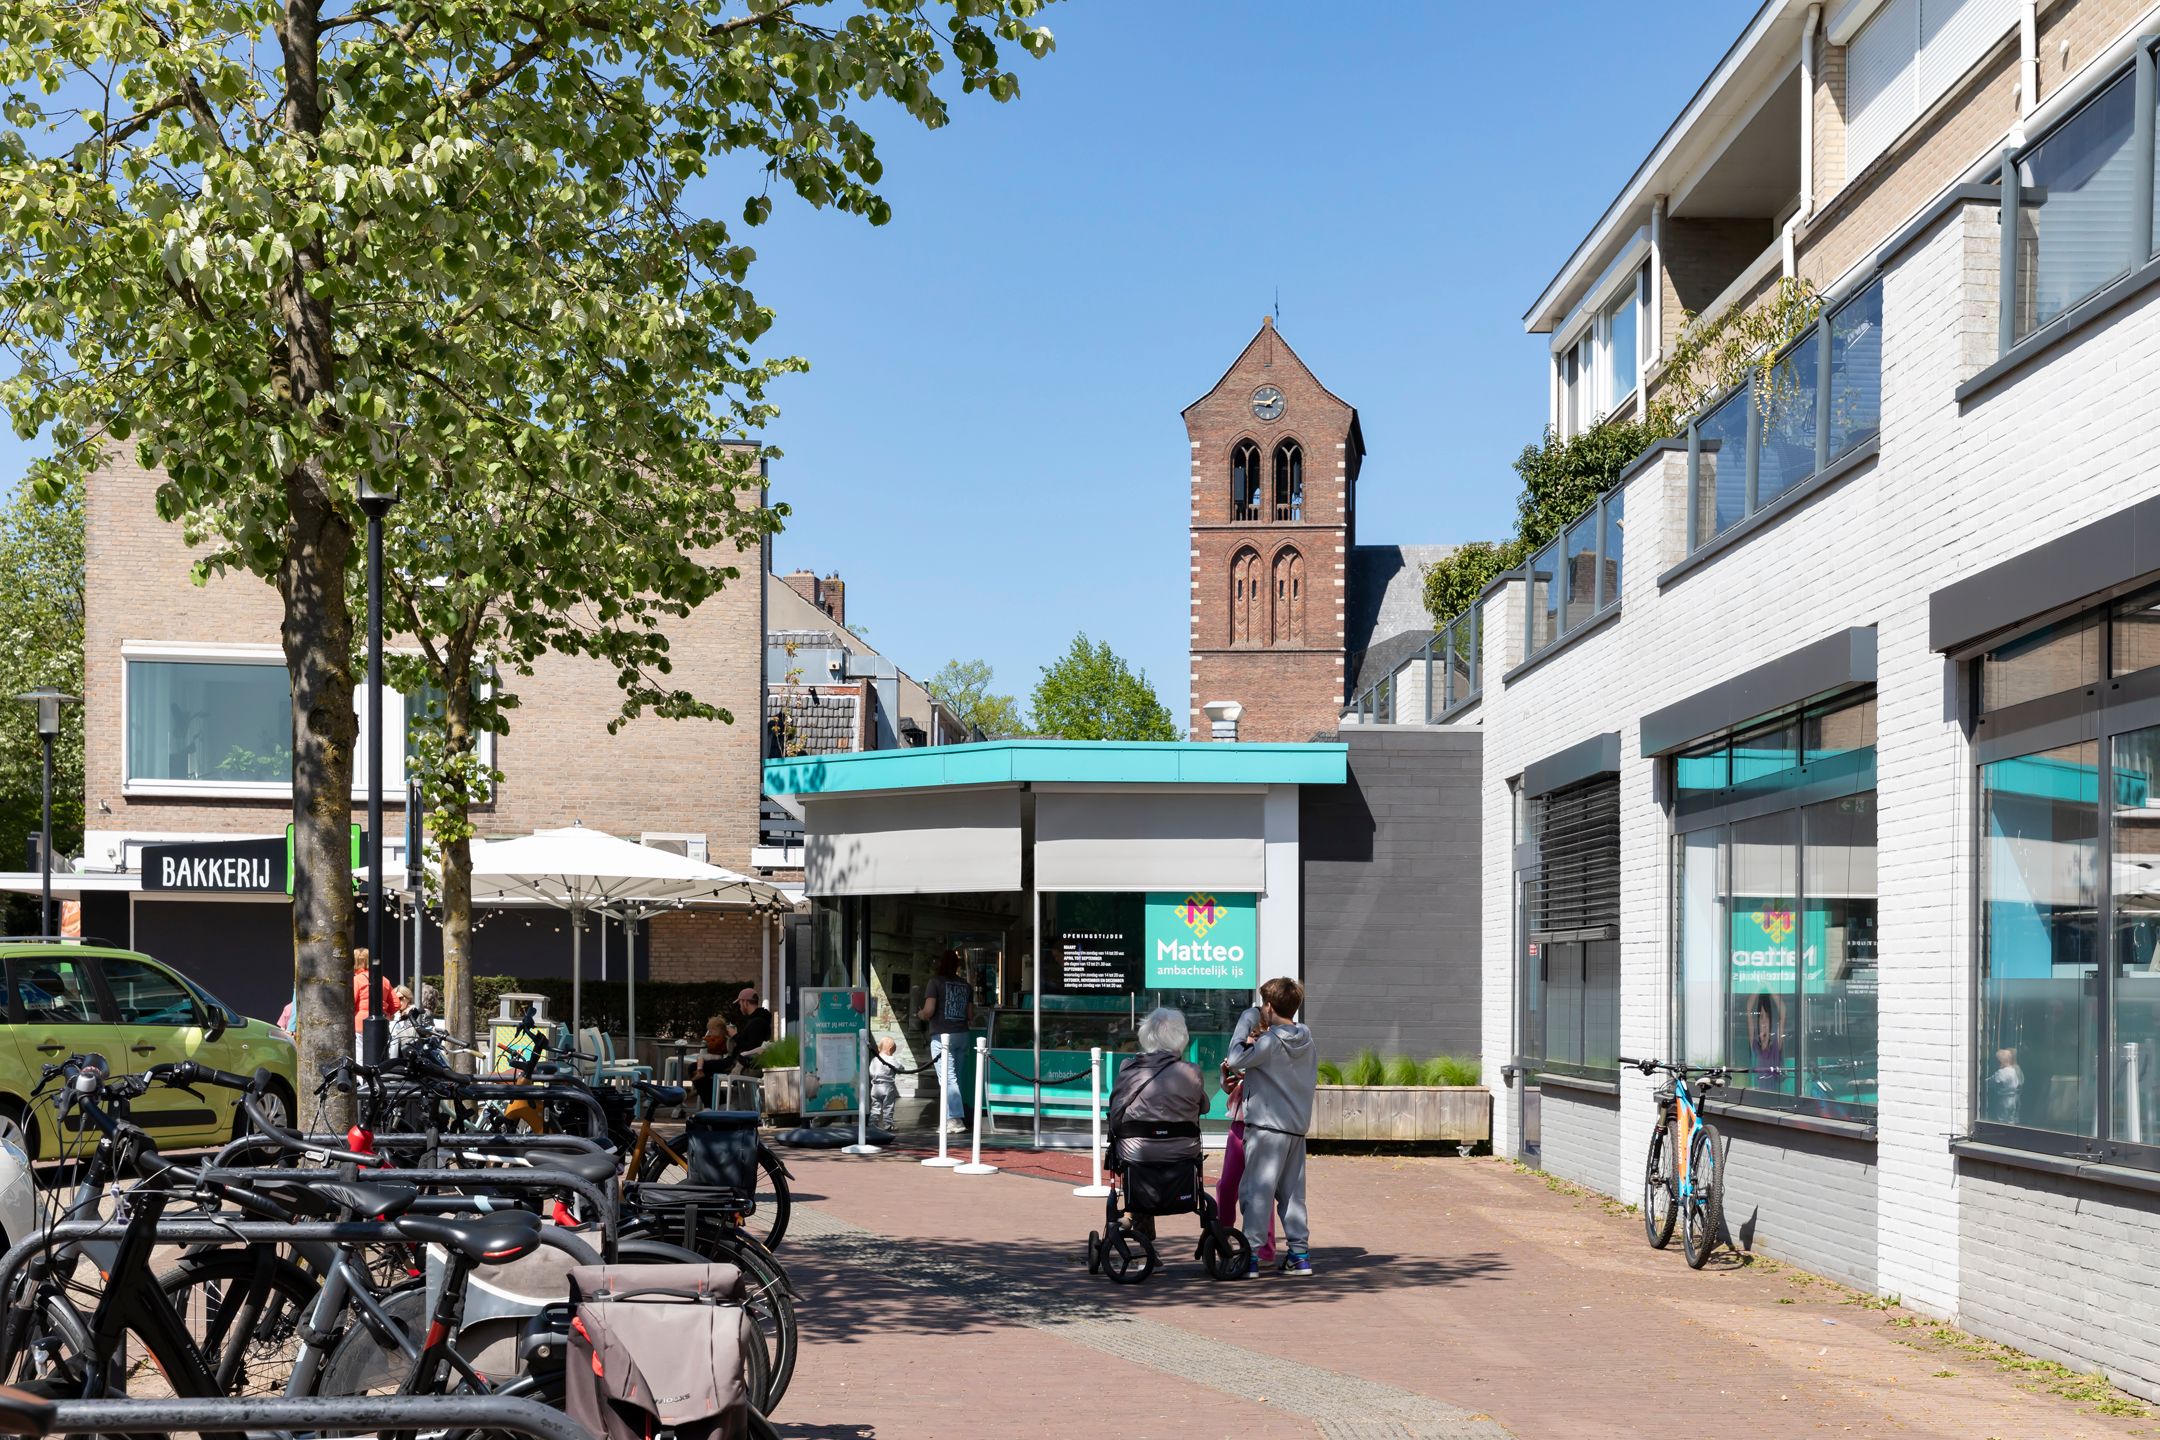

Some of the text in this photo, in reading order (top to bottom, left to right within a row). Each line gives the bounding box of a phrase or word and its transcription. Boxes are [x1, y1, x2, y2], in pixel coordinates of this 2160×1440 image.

[162, 856, 270, 888] BAKKERIJ
[1157, 939, 1244, 962] Matteo
[1157, 965, 1244, 979] ambachtelijk ijs
